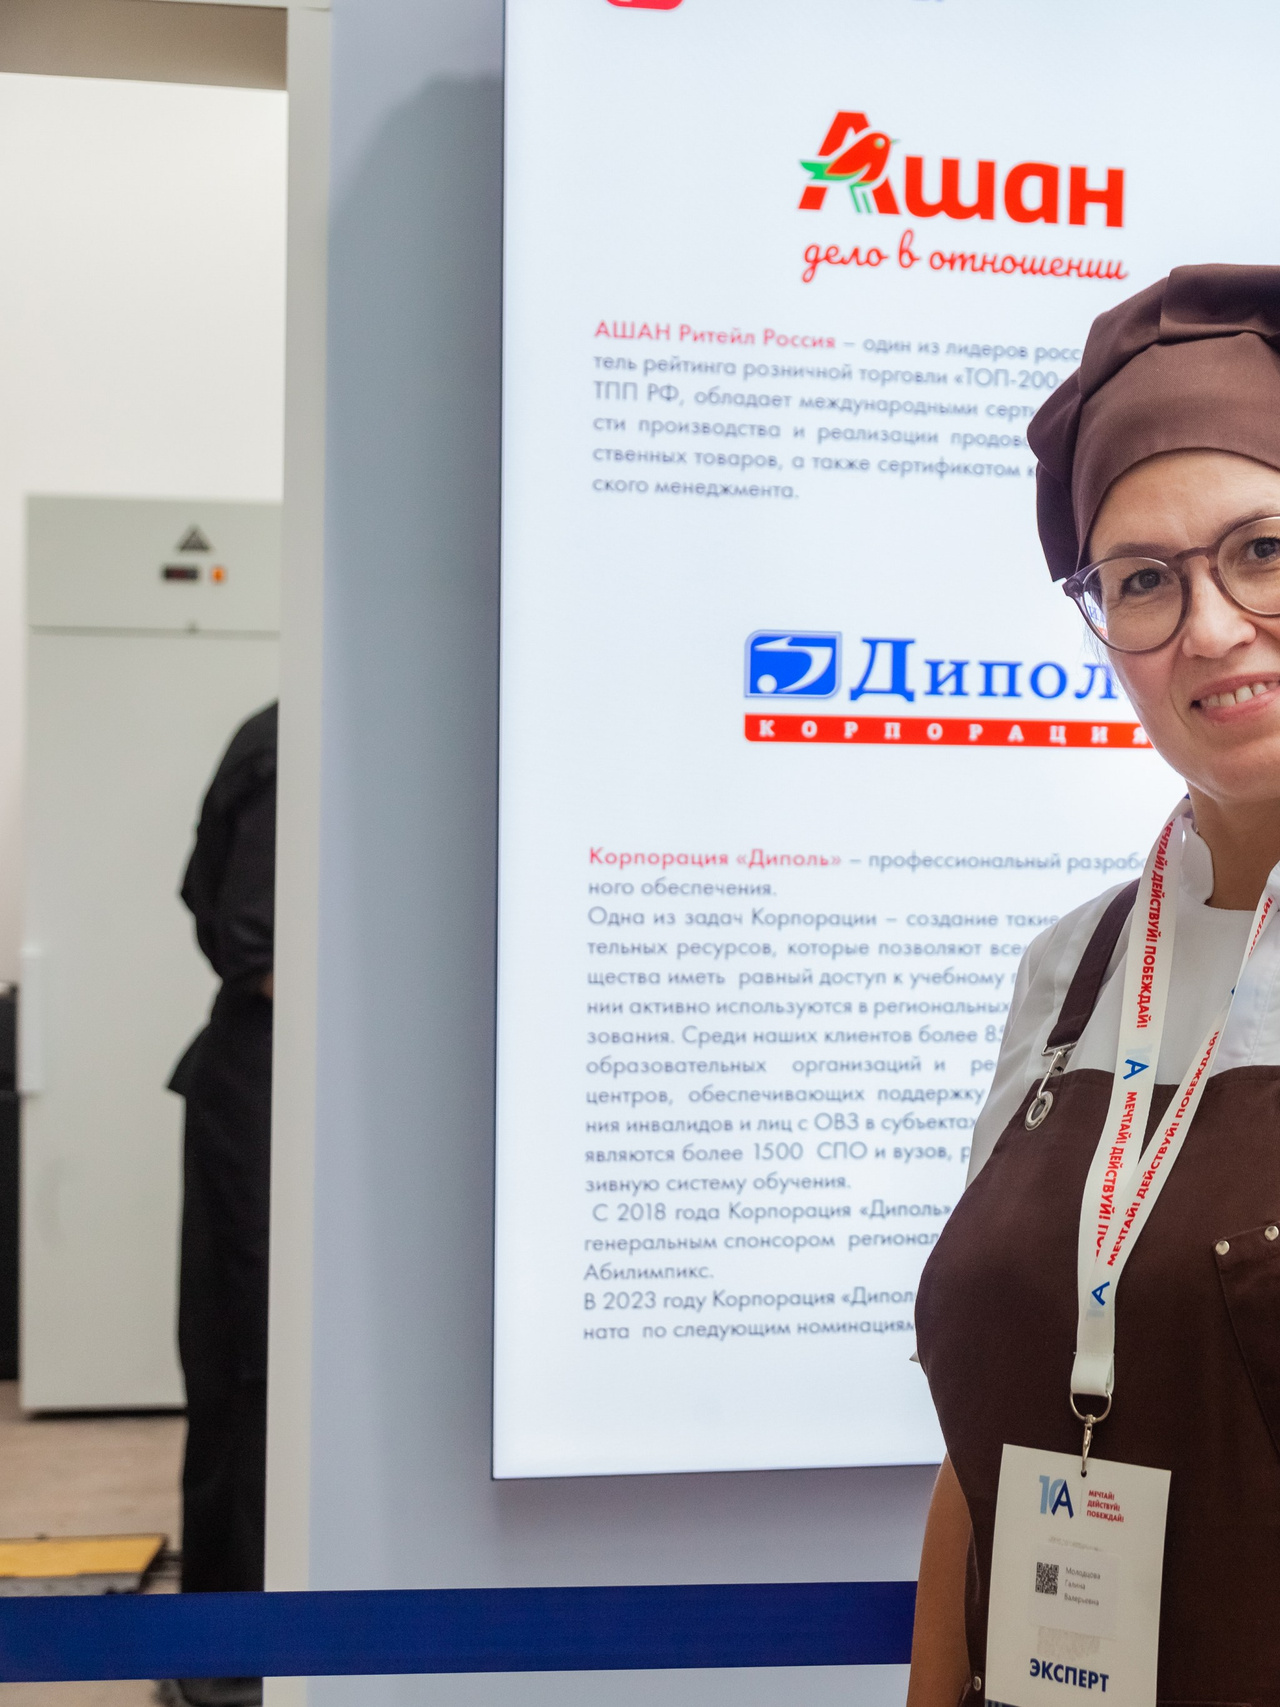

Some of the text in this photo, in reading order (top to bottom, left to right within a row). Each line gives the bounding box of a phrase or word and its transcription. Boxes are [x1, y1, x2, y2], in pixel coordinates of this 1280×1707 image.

[797, 110, 1125, 229] Ашан
[802, 228, 1128, 284] дело в отношении
[594, 319, 671, 341] АШАН
[679, 323, 756, 346] Ритейл
[763, 327, 836, 350] Россия
[862, 337, 913, 357] один
[919, 340, 941, 357] из
[945, 341, 1030, 364] лидеров
[593, 354, 1062, 391] тель рейтинга розничной торговли «ТОП-200
[592, 379, 640, 403] ТПП
[646, 382, 686, 408] РФ,
[693, 383, 794, 411] обладает
[798, 395, 979, 419] международными
[592, 416, 627, 433] сти
[637, 418, 782, 440] производства
[792, 425, 807, 440] и
[816, 426, 940, 447] реализации
[592, 447, 688, 466] ственных
[693, 451, 784, 475] товаров,
[790, 454, 807, 472] а
[811, 456, 872, 473] также
[876, 455, 1022, 481] сертификатом
[591, 477, 800, 501] ского менеджмента.
[758, 719, 1150, 745] КОРПОРАЦИЯ
[589, 846, 730, 871] Корпорация
[736, 847, 842, 871] «Диполь»
[868, 849, 1063, 875] профессиональный
[587, 875, 778, 898] ного обеспечения.
[587, 904, 646, 929] Одна
[653, 911, 677, 927] из
[684, 911, 744, 929] задач
[751, 906, 878, 933] Корпорации
[906, 913, 1000, 930] создание
[1146, 870, 1166, 943] ДЕЙСТВУЙ!
[587, 941, 1026, 962] тельных ресурсов, которые позволяют все
[587, 971, 662, 988] щества
[667, 971, 727, 987] иметь
[738, 967, 815, 991] равный
[818, 971, 888, 991] доступ
[893, 972, 904, 985] к
[909, 965, 1006, 991] учебному
[1136, 945, 1157, 1029] ПОБЕЖДАЙ!
[587, 1001, 624, 1015] нии
[629, 1001, 712, 1016] активно
[715, 1000, 854, 1021] используются
[858, 1001, 869, 1015] в
[587, 1030, 676, 1046] зования.
[681, 1023, 748, 1051] Среди
[753, 1030, 819, 1045] наших
[824, 1029, 914, 1045] клиентов
[918, 1023, 979, 1045] более
[585, 1053, 768, 1081] образовательных
[791, 1054, 923, 1079] организаций
[934, 1059, 947, 1073] и
[586, 1082, 985, 1110] центров, обеспечивающих поддержку
[585, 1120, 621, 1134] ния
[626, 1118, 735, 1135] инвалидов
[739, 1119, 752, 1132] и
[756, 1118, 794, 1134] лиц
[796, 1117, 810, 1133] с
[813, 1111, 861, 1133] ОВЗ
[865, 1117, 876, 1132] в
[1115, 1091, 1138, 1145] МЕЧТАЙ!
[584, 1148, 676, 1164] являются
[681, 1141, 745, 1164] более
[753, 1140, 805, 1163] 1500
[816, 1140, 869, 1162] СПО
[874, 1147, 887, 1160] и
[893, 1145, 953, 1165] вузов,
[1107, 1202, 1141, 1267] МЕЧТАЙ!
[1136, 1122, 1180, 1199] ДЕЙСТВУЙ!
[1175, 1030, 1220, 1118] ПОБЕЖДАЙ!
[585, 1170, 852, 1198] зивную систему обучения.
[1098, 1146, 1125, 1221] ДЕЙСТВУЙ!
[591, 1198, 952, 1226] С 2018 года Корпорация «Диполь»
[584, 1236, 719, 1257] генеральным
[723, 1234, 837, 1254] спонсором
[583, 1260, 715, 1282] Абилимпикс.
[584, 1285, 915, 1315] В 2023 году Корпорация «Дипол
[583, 1326, 631, 1341] ната
[642, 1324, 669, 1340] по
[672, 1323, 792, 1343] следующим
[1087, 1500, 1121, 1512] ДЕЙСТВУЙ!
[1088, 1490, 1115, 1501] МЕЧТАЙ!
[1086, 1510, 1125, 1523] ПОБЕЖДАЙ!
[1029, 1658, 1109, 1692] ЭКСПЕРТ
